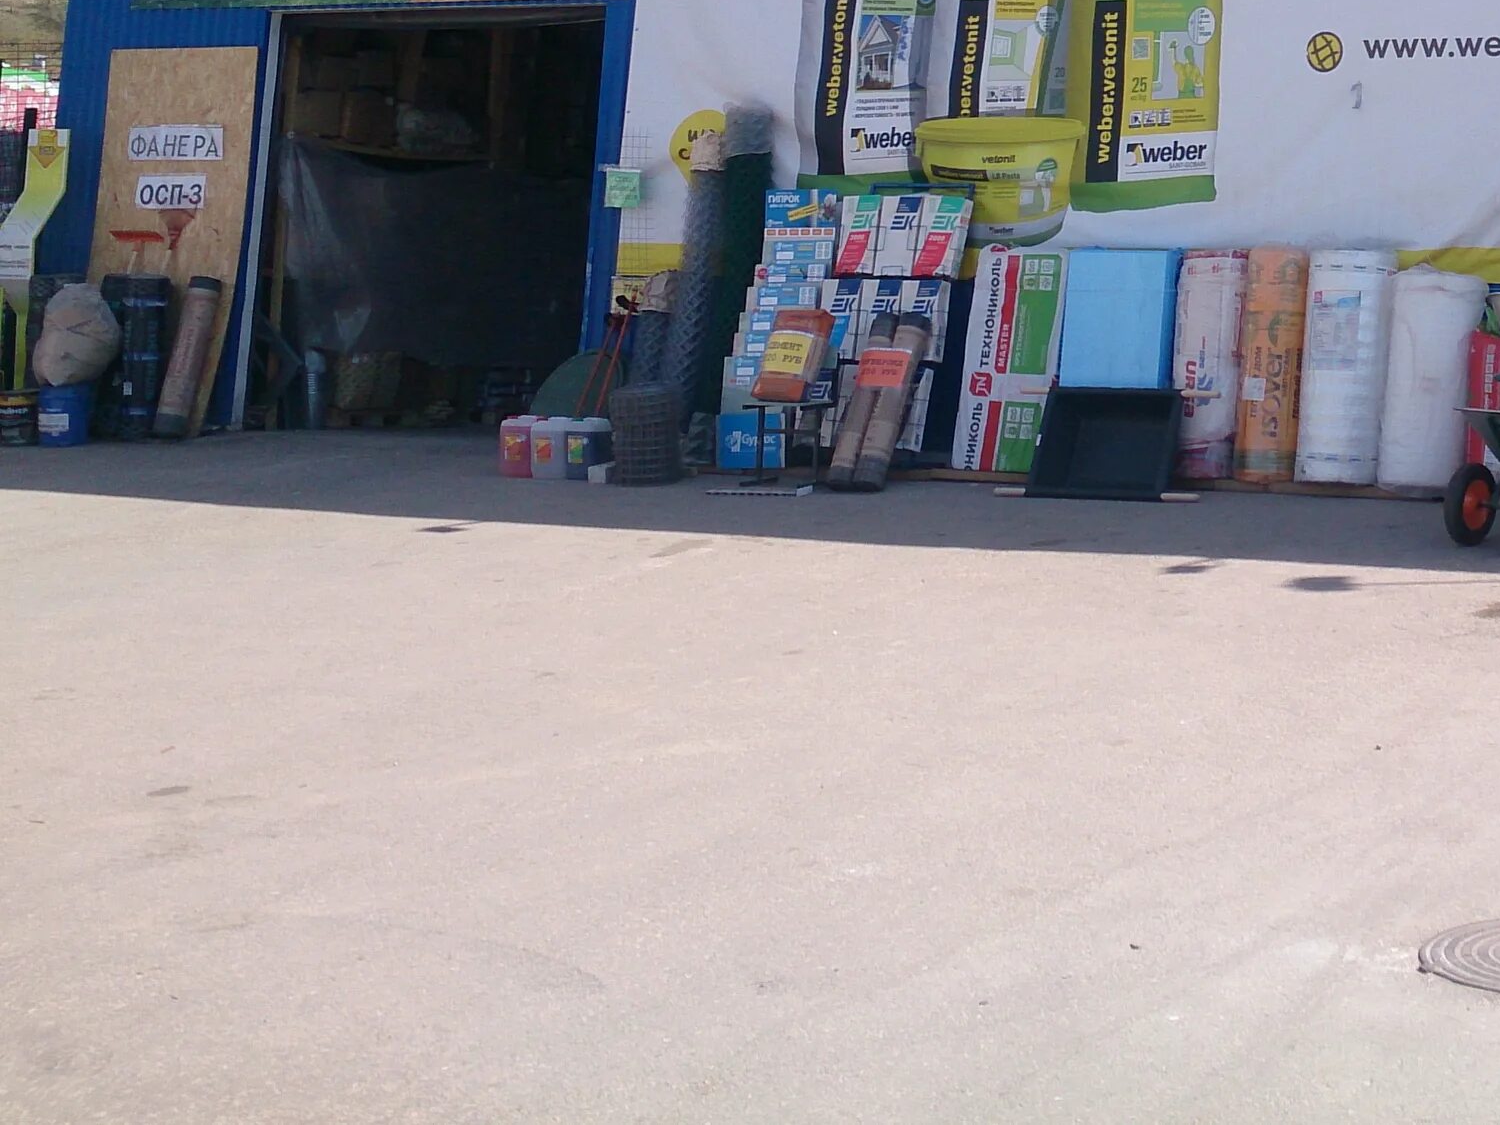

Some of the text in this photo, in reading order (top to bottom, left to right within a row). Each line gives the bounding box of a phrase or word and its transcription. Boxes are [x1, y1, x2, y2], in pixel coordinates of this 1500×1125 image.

[1097, 11, 1119, 164] weber.vetonit
[1131, 76, 1149, 94] 25
[131, 134, 221, 158] ФАНЕРА
[1142, 140, 1208, 163] weber
[981, 154, 1016, 165] vetonit
[139, 183, 203, 205] ОСП-3
[767, 194, 801, 204] ГИПРОК
[979, 256, 1002, 369] ТЕХНОНИКОЛЬ
[997, 323, 1010, 367] MASTER
[781, 353, 803, 365] РУБ
[741, 432, 777, 450] Gypoc
